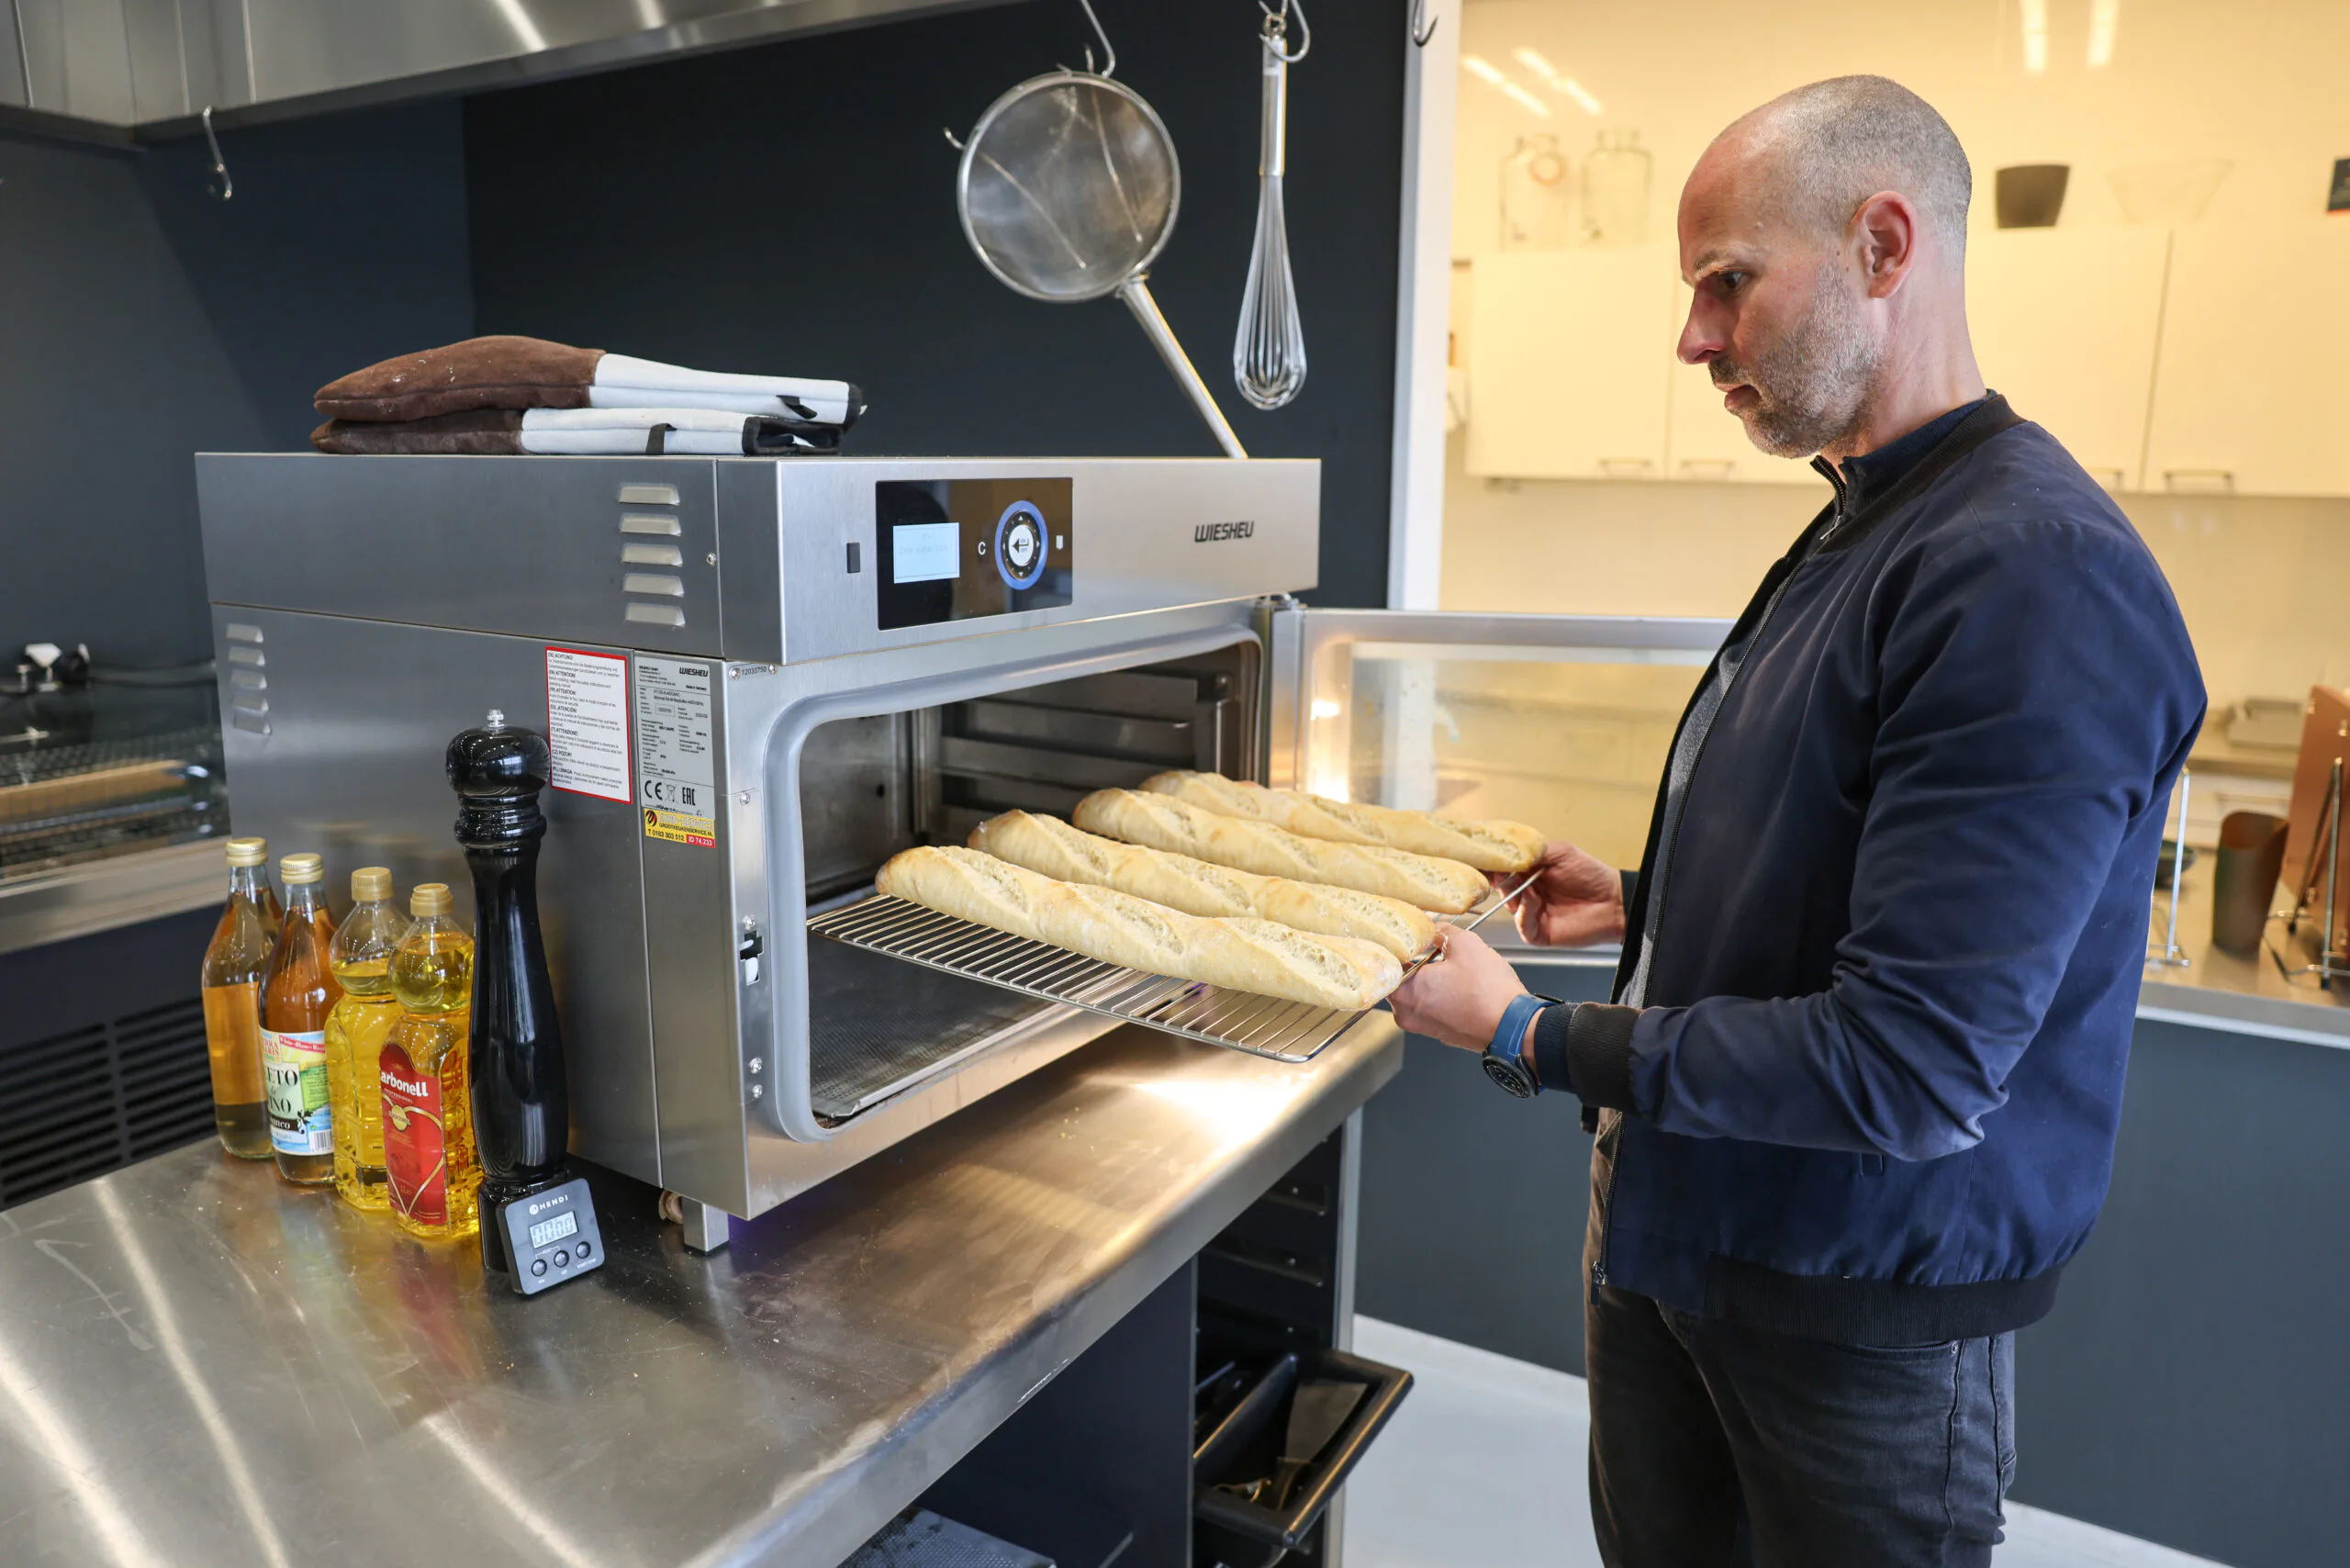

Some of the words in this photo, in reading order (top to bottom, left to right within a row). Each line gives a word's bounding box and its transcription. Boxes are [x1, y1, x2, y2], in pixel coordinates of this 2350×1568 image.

[1194, 521, 1254, 543] WIESHEU
[679, 666, 709, 678] WIESHEU
[742, 666, 767, 676] 12033750
[682, 787, 696, 806] EAC
[652, 830, 665, 838] 0183
[665, 832, 675, 840] 303
[675, 834, 685, 842] 512
[539, 1194, 568, 1210] HENDI
